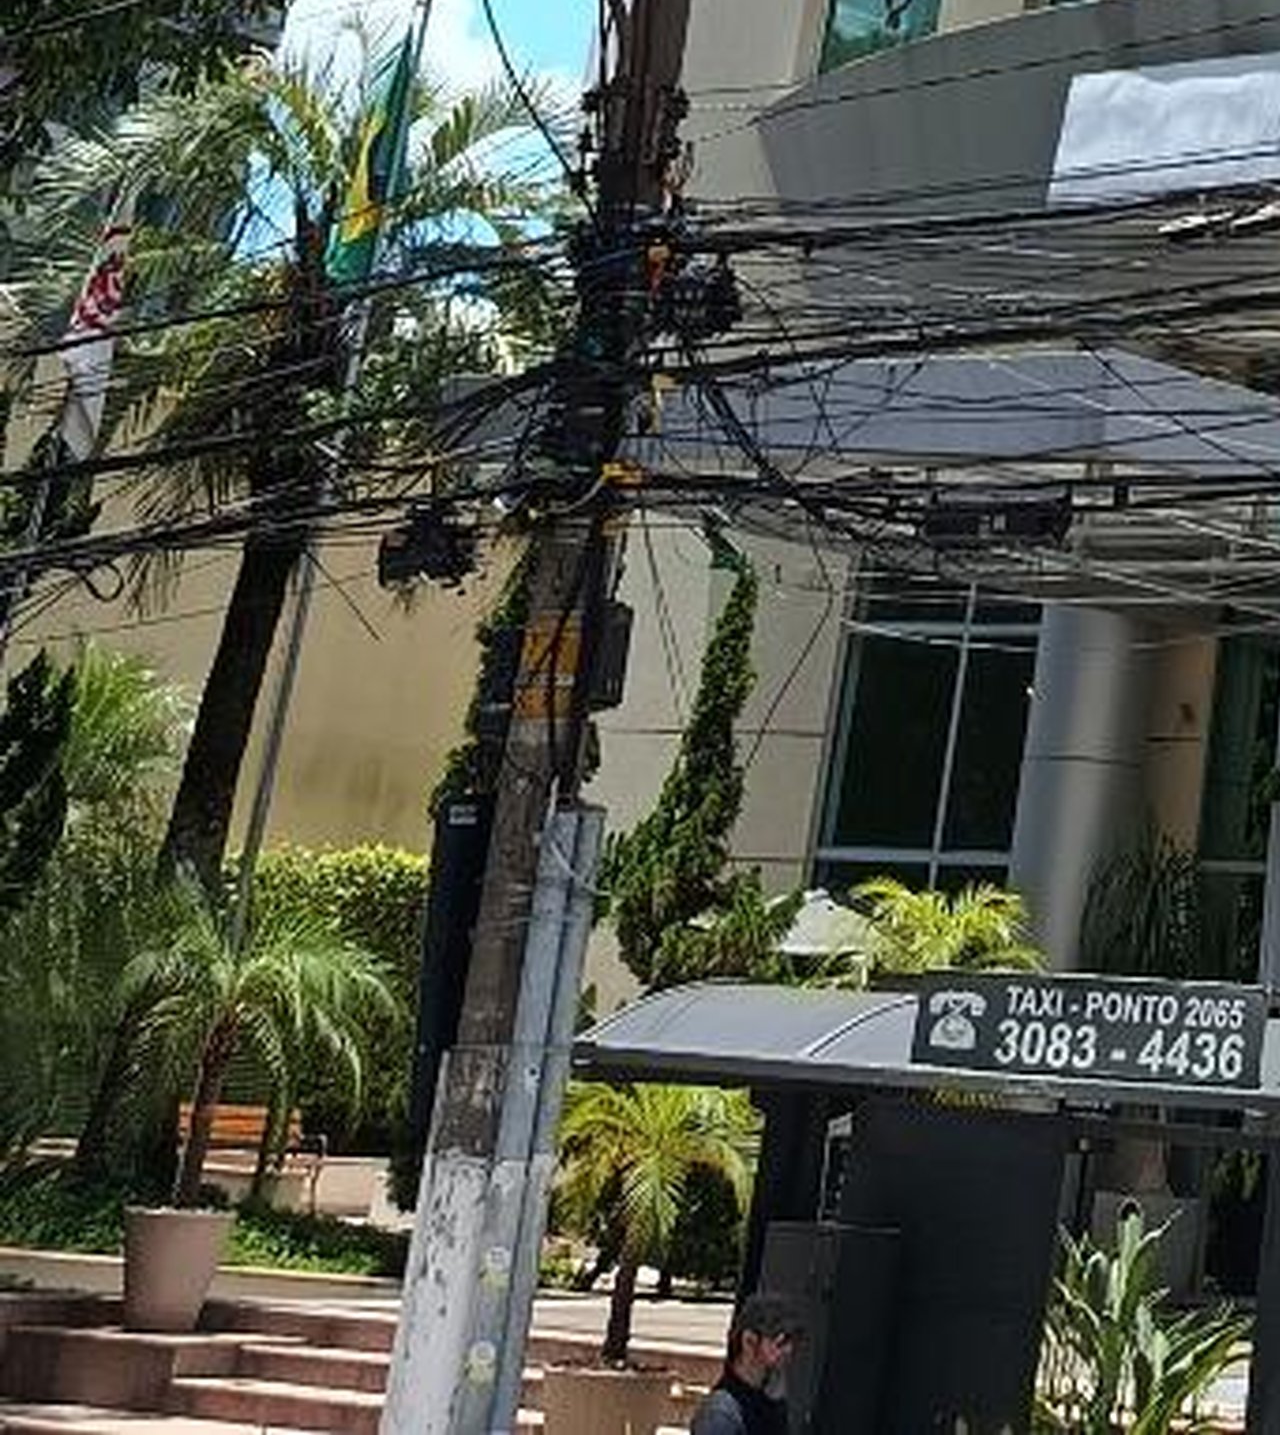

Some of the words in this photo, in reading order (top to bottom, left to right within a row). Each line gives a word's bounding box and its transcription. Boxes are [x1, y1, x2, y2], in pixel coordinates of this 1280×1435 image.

[1007, 985, 1063, 1016] TAXI
[1085, 992, 1179, 1025] PONTO
[1184, 997, 1247, 1031] 2065
[993, 1019, 1098, 1069] 3083
[1136, 1028, 1247, 1080] 4436
